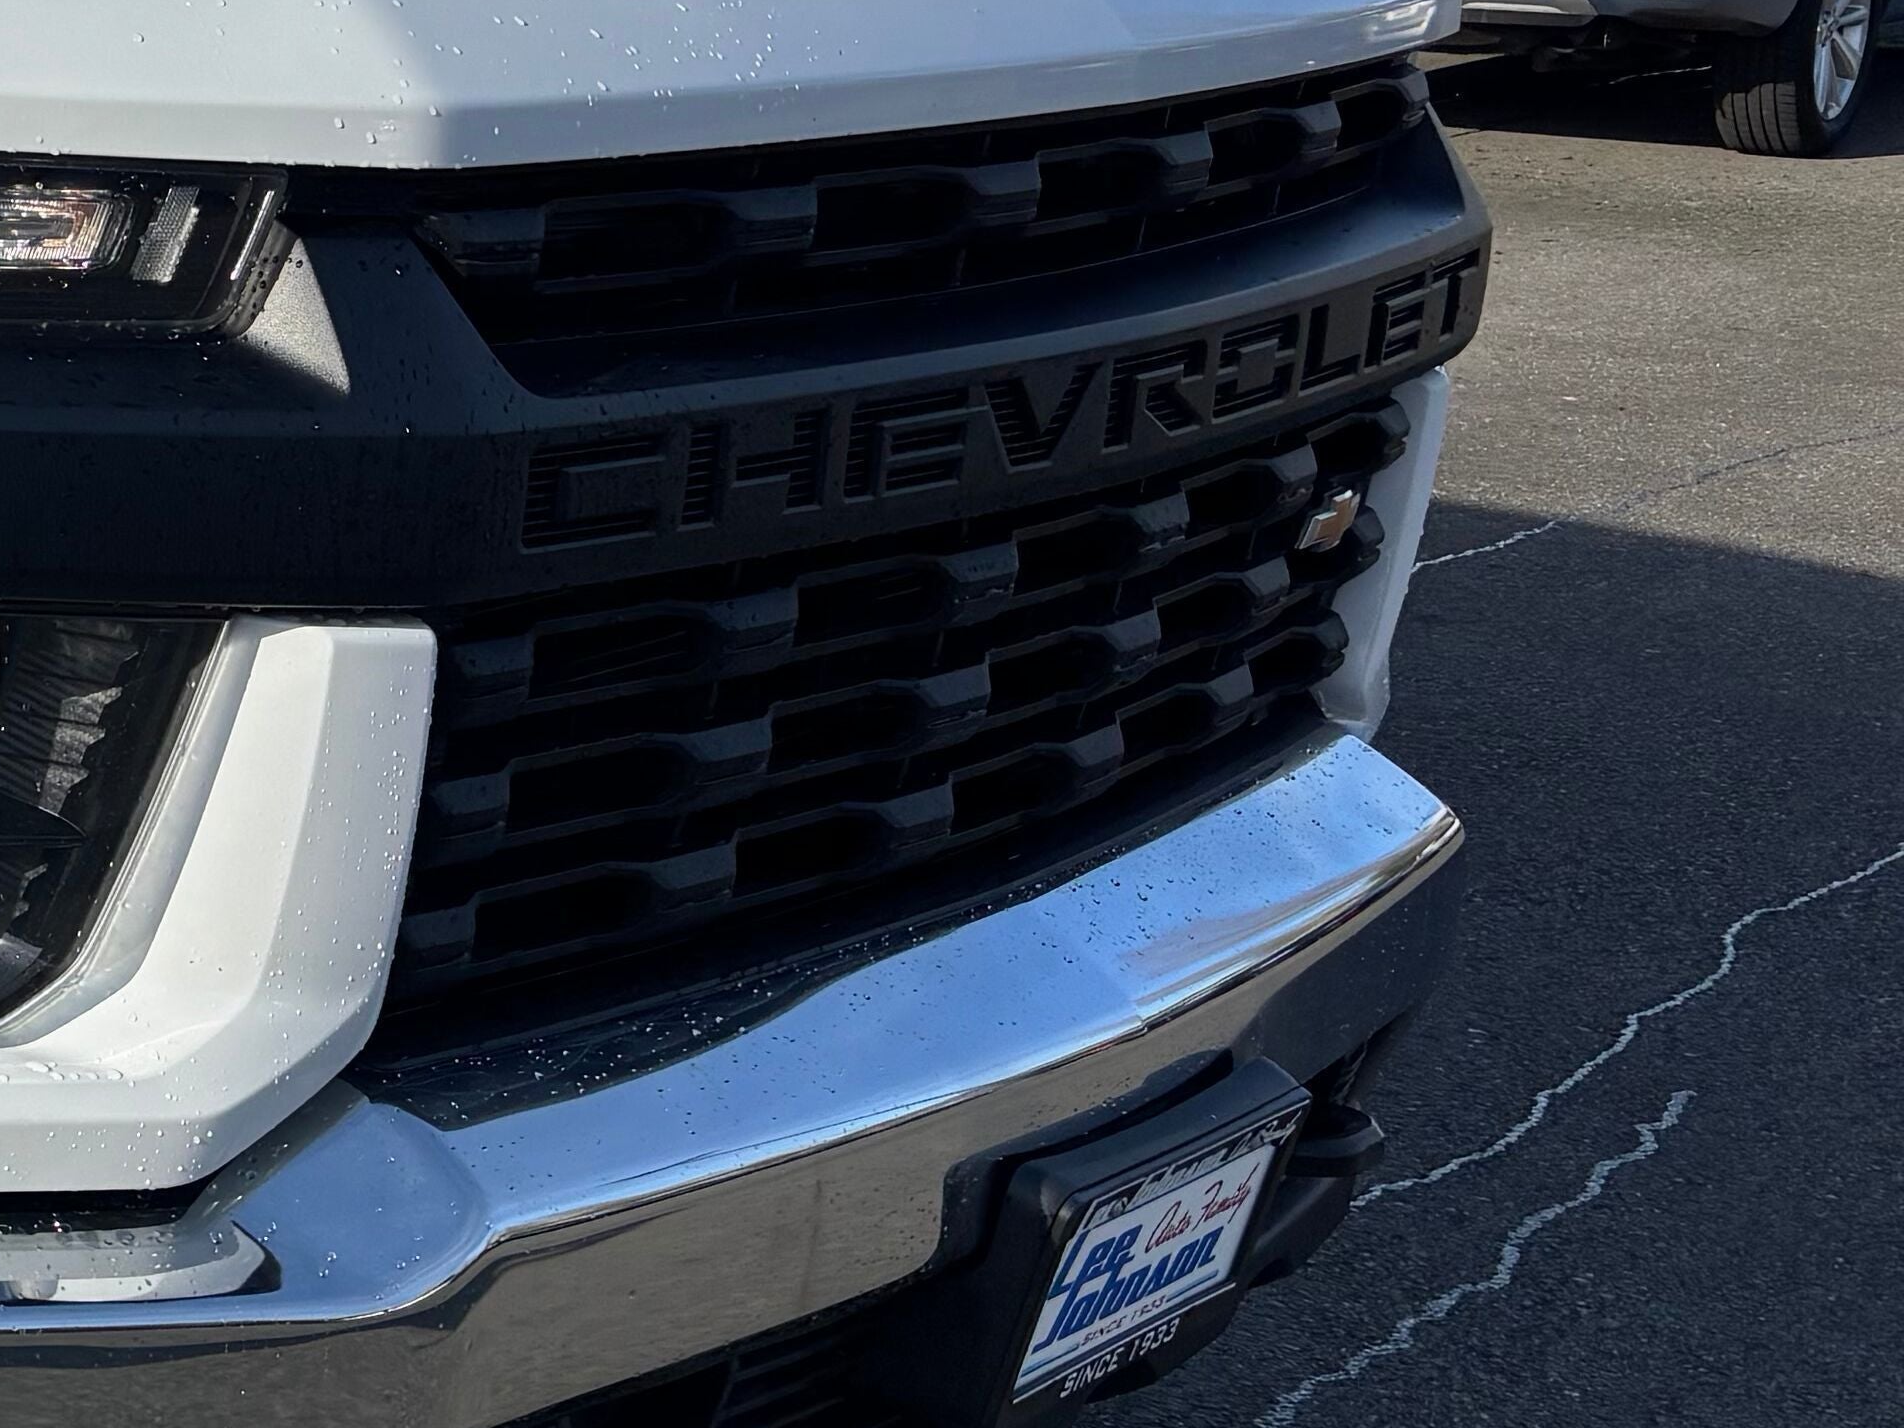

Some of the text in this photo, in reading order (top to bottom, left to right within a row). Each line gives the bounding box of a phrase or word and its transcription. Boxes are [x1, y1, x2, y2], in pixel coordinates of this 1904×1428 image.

[520, 248, 1481, 554] CHEVROLET
[1032, 1226, 1224, 1355] Johnson
[1047, 1224, 1143, 1301] Lee
[1144, 1200, 1192, 1253] Auto
[1060, 1317, 1181, 1398] SINCE 1933
[1081, 1317, 1128, 1346] SINCE
